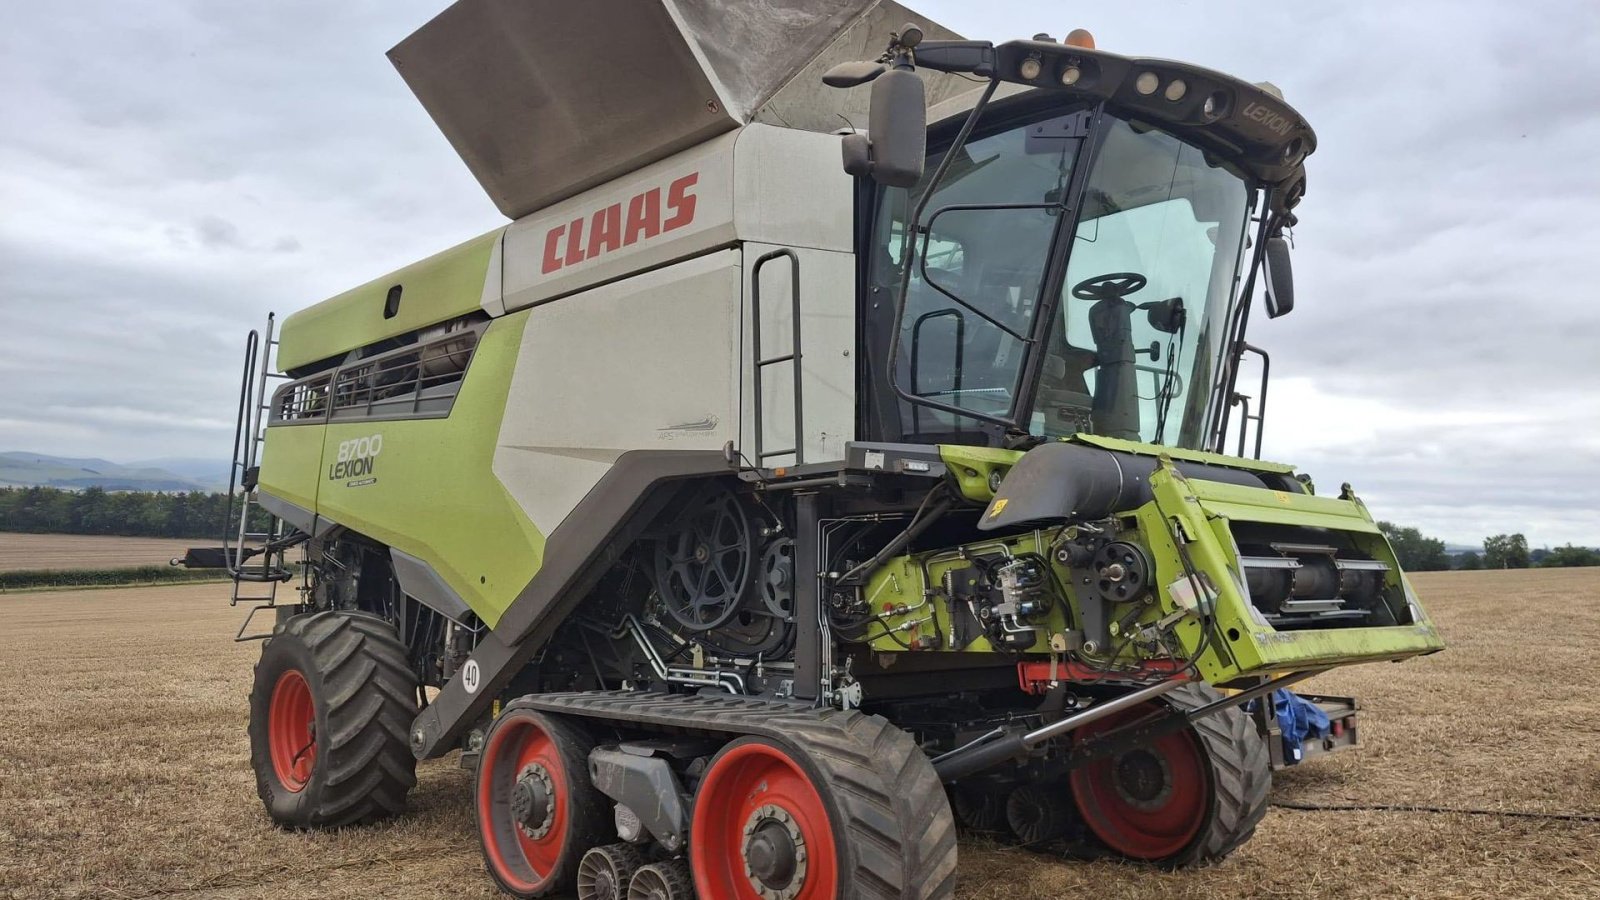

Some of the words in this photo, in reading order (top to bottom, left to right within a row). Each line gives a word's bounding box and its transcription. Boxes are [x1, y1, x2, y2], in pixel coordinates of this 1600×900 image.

[1243, 102, 1294, 136] LEXION
[542, 172, 699, 274] CLAAS
[338, 434, 383, 462] 8700
[329, 456, 375, 480] LEXION
[465, 665, 476, 686] 40
